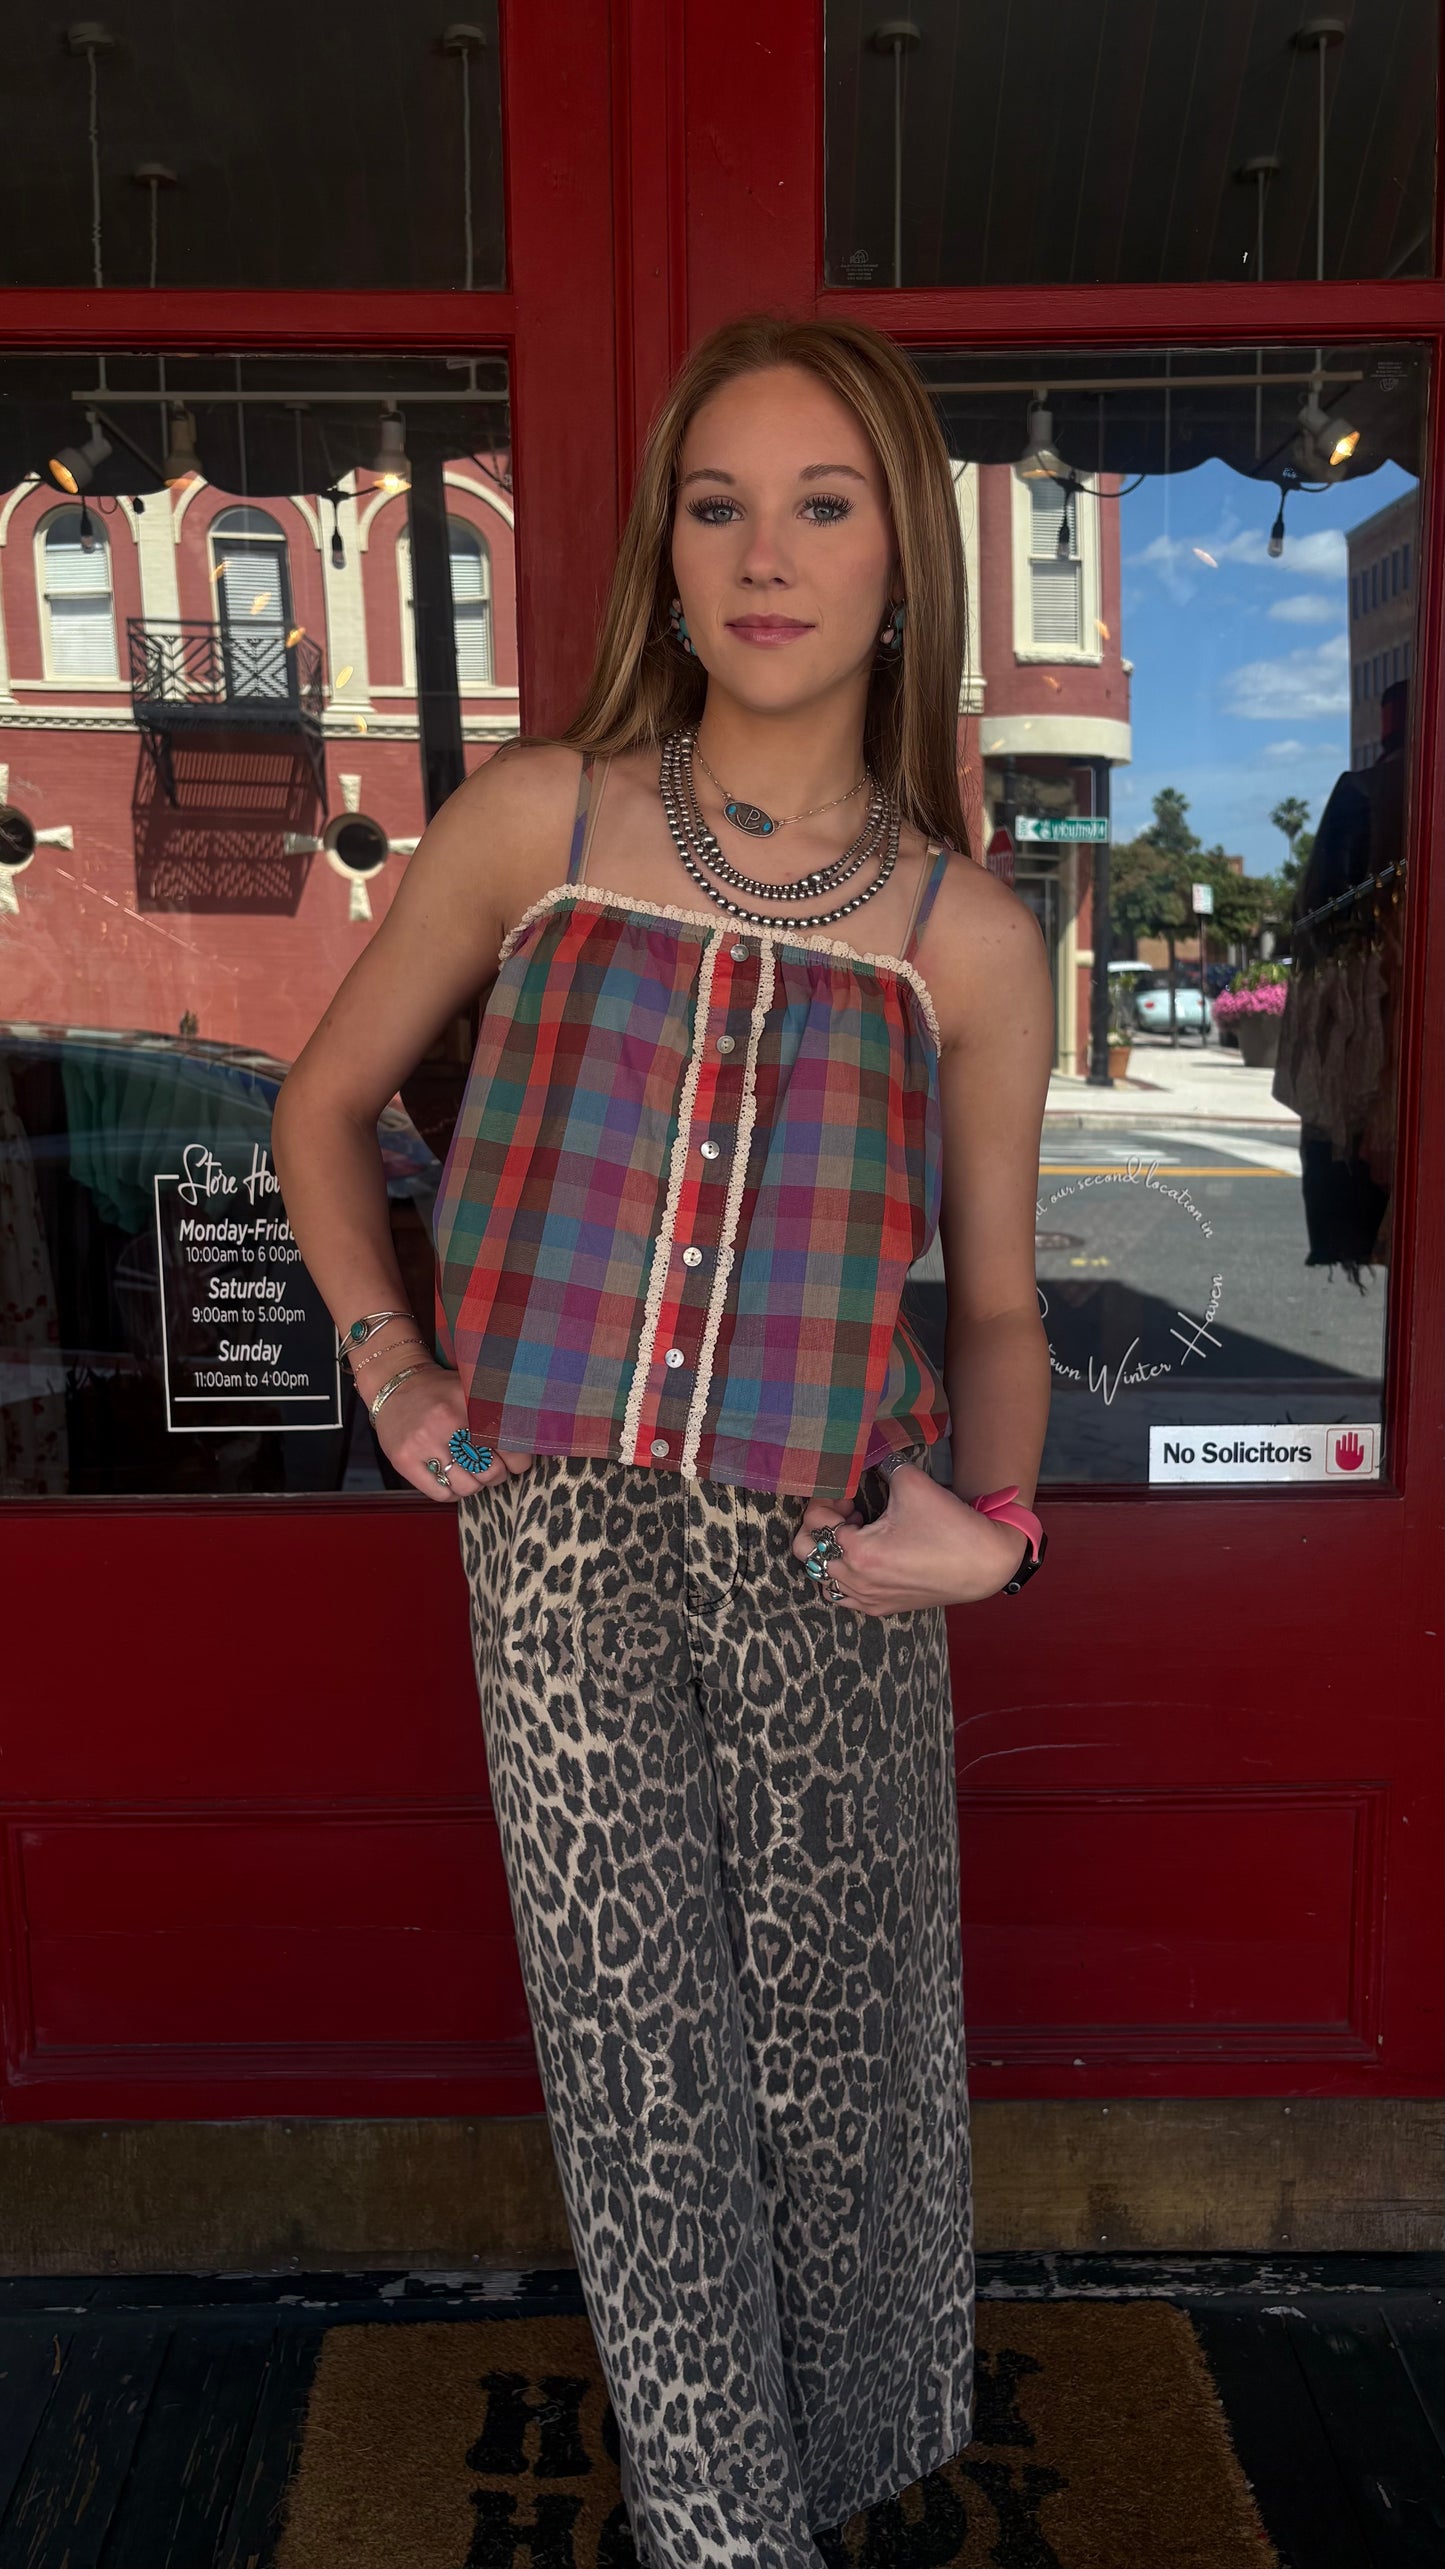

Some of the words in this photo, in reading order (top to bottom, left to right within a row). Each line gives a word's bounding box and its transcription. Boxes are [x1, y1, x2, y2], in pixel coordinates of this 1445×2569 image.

[178, 1143, 238, 1206] Store
[243, 1142, 281, 1206] Hou
[1050, 1185, 1076, 1203] our
[1078, 1155, 1142, 1189] second
[1145, 1159, 1203, 1221] location
[1201, 1221, 1214, 1239] in
[180, 1218, 295, 1245] Monday-Frid
[186, 1246, 239, 1263] 10:00am
[241, 1246, 255, 1262] to
[208, 1276, 286, 1303] Saturday
[192, 1306, 239, 1323] 9:00am
[242, 1307, 255, 1322] to
[218, 1338, 282, 1366] Sunday
[1088, 1336, 1172, 1406] Winter
[1170, 1274, 1223, 1366] Haven
[194, 1371, 243, 1388] 11:00am
[245, 1371, 258, 1387] to
[1163, 1442, 1196, 1464] No
[1201, 1441, 1313, 1464] Solicitors
